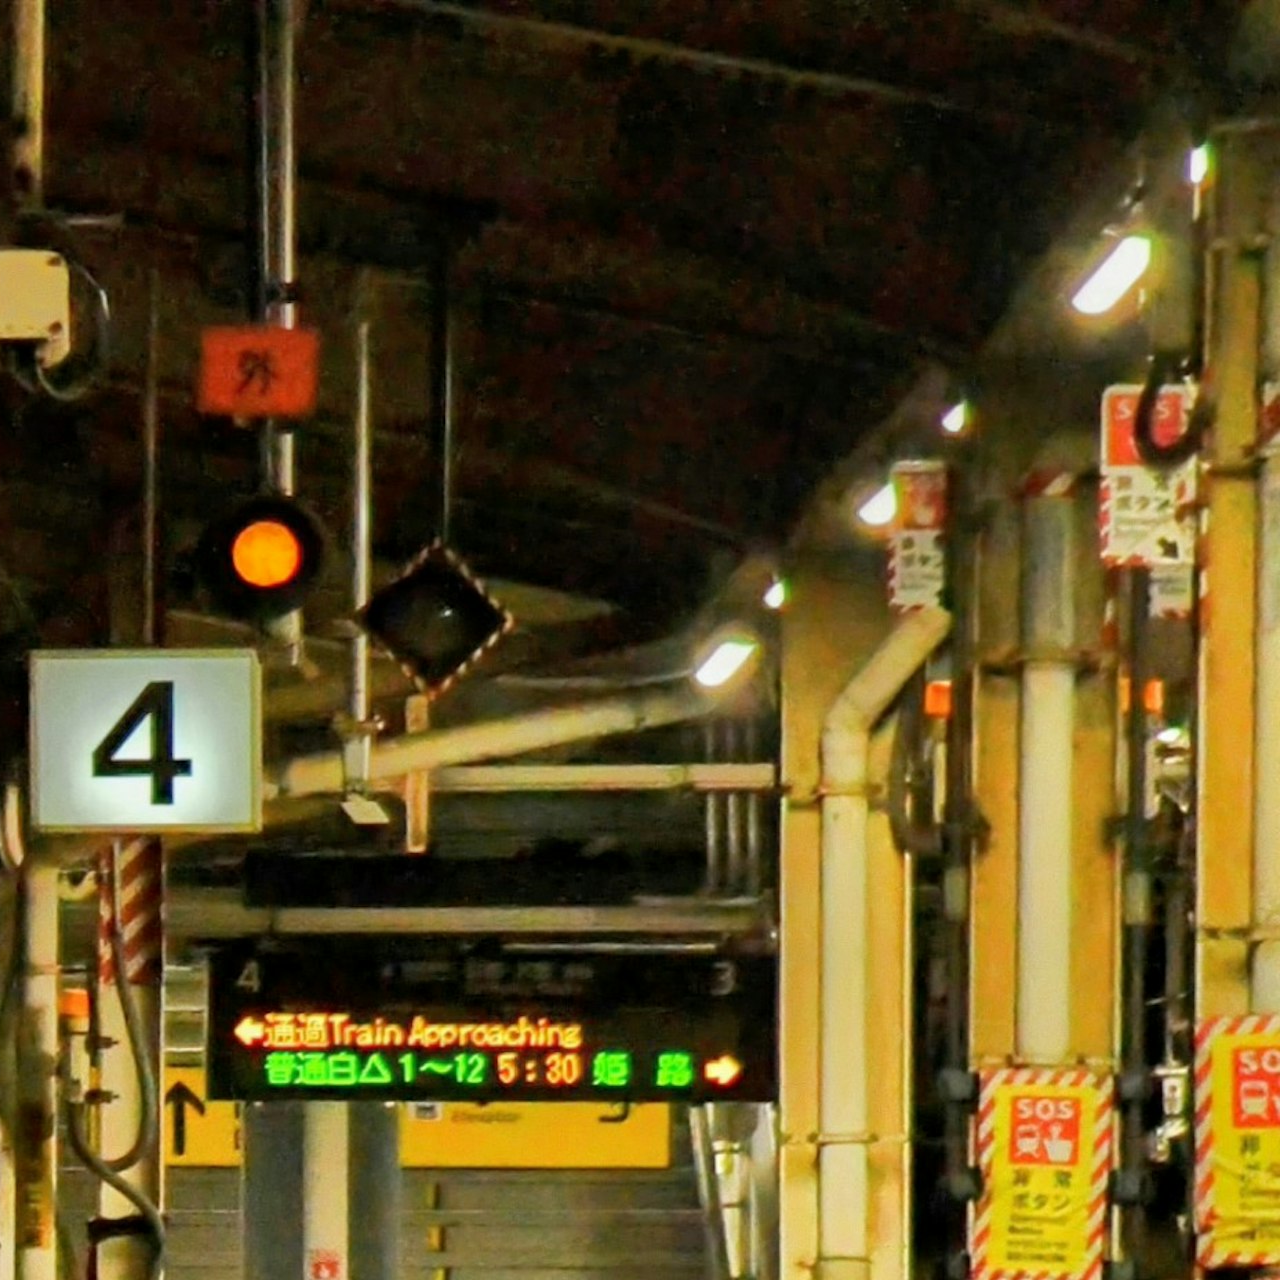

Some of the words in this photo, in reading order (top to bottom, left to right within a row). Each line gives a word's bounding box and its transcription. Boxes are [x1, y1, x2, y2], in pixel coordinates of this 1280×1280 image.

[92, 680, 193, 805] 4
[236, 960, 261, 993] 4
[711, 960, 736, 997] 3
[1015, 1098, 1074, 1121] SOS
